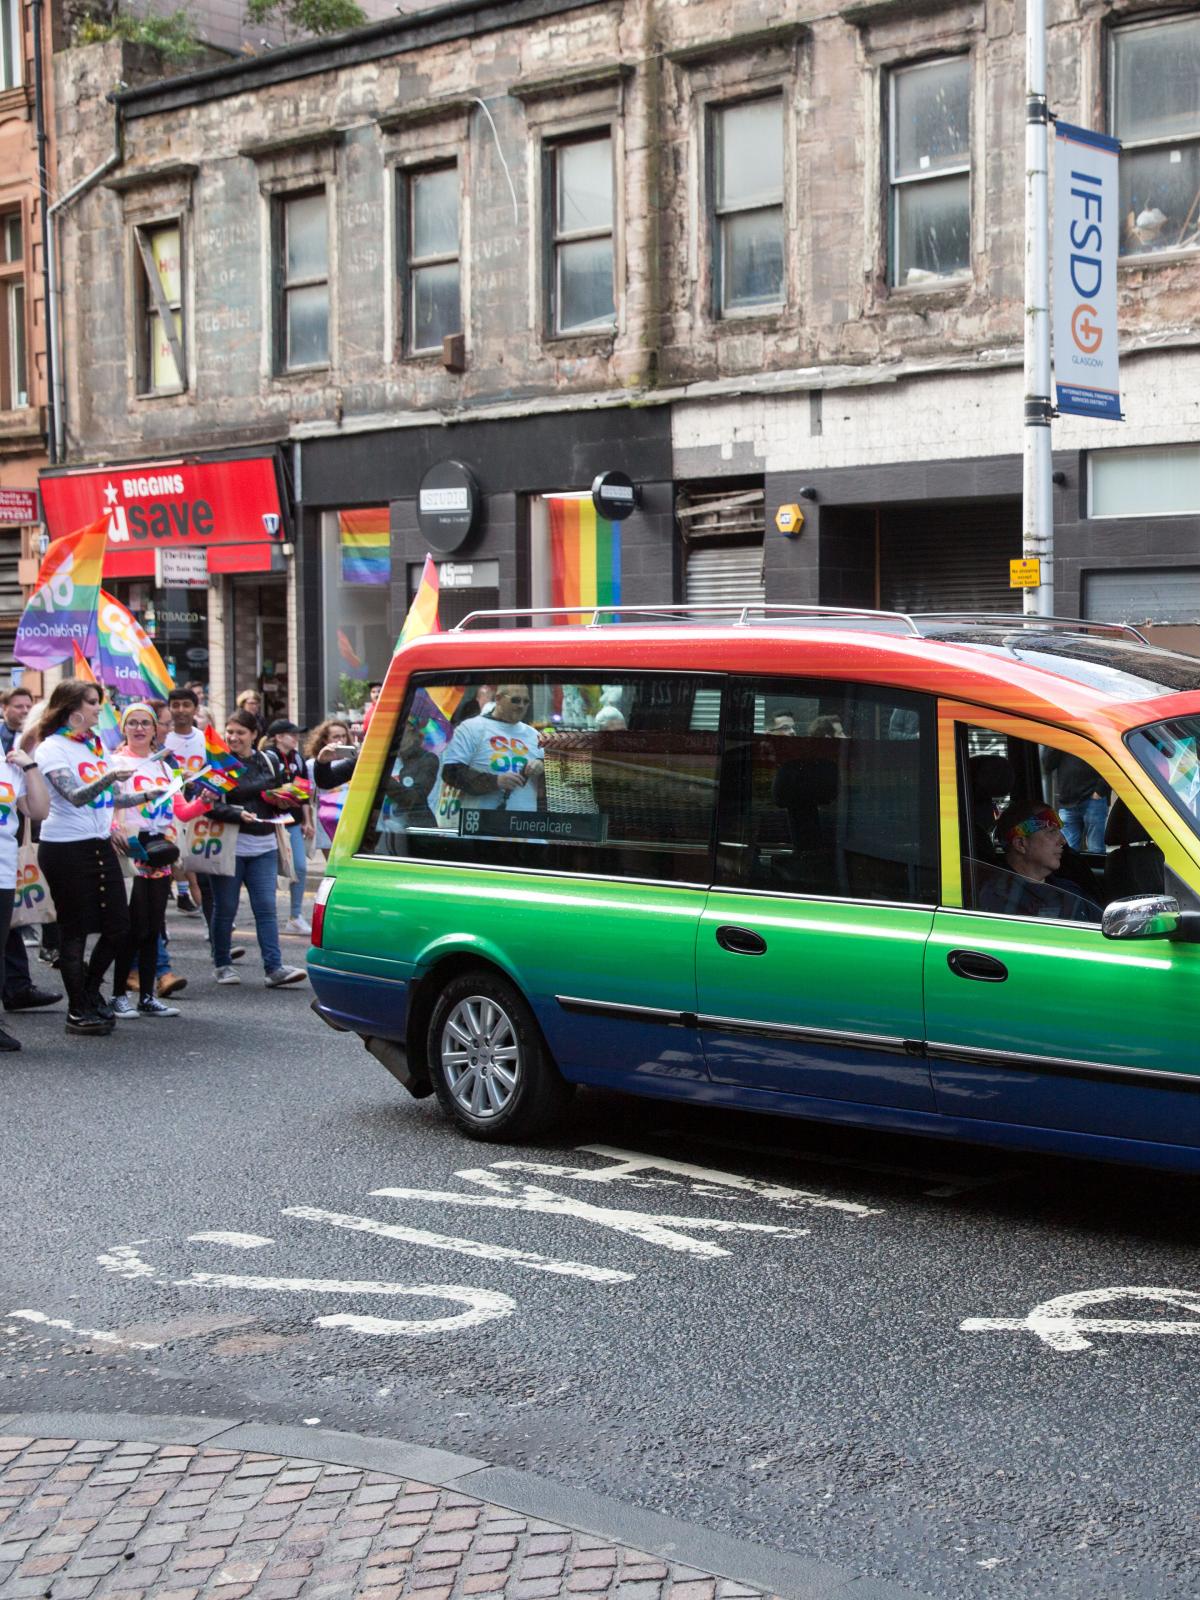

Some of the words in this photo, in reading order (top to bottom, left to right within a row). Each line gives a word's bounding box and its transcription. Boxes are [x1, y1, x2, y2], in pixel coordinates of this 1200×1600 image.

[1070, 169, 1103, 300] IFSD
[1072, 355, 1104, 368] GLASGOW
[122, 474, 185, 499] BIGGINS
[103, 500, 215, 543] usave
[509, 816, 572, 833] Funeralcare
